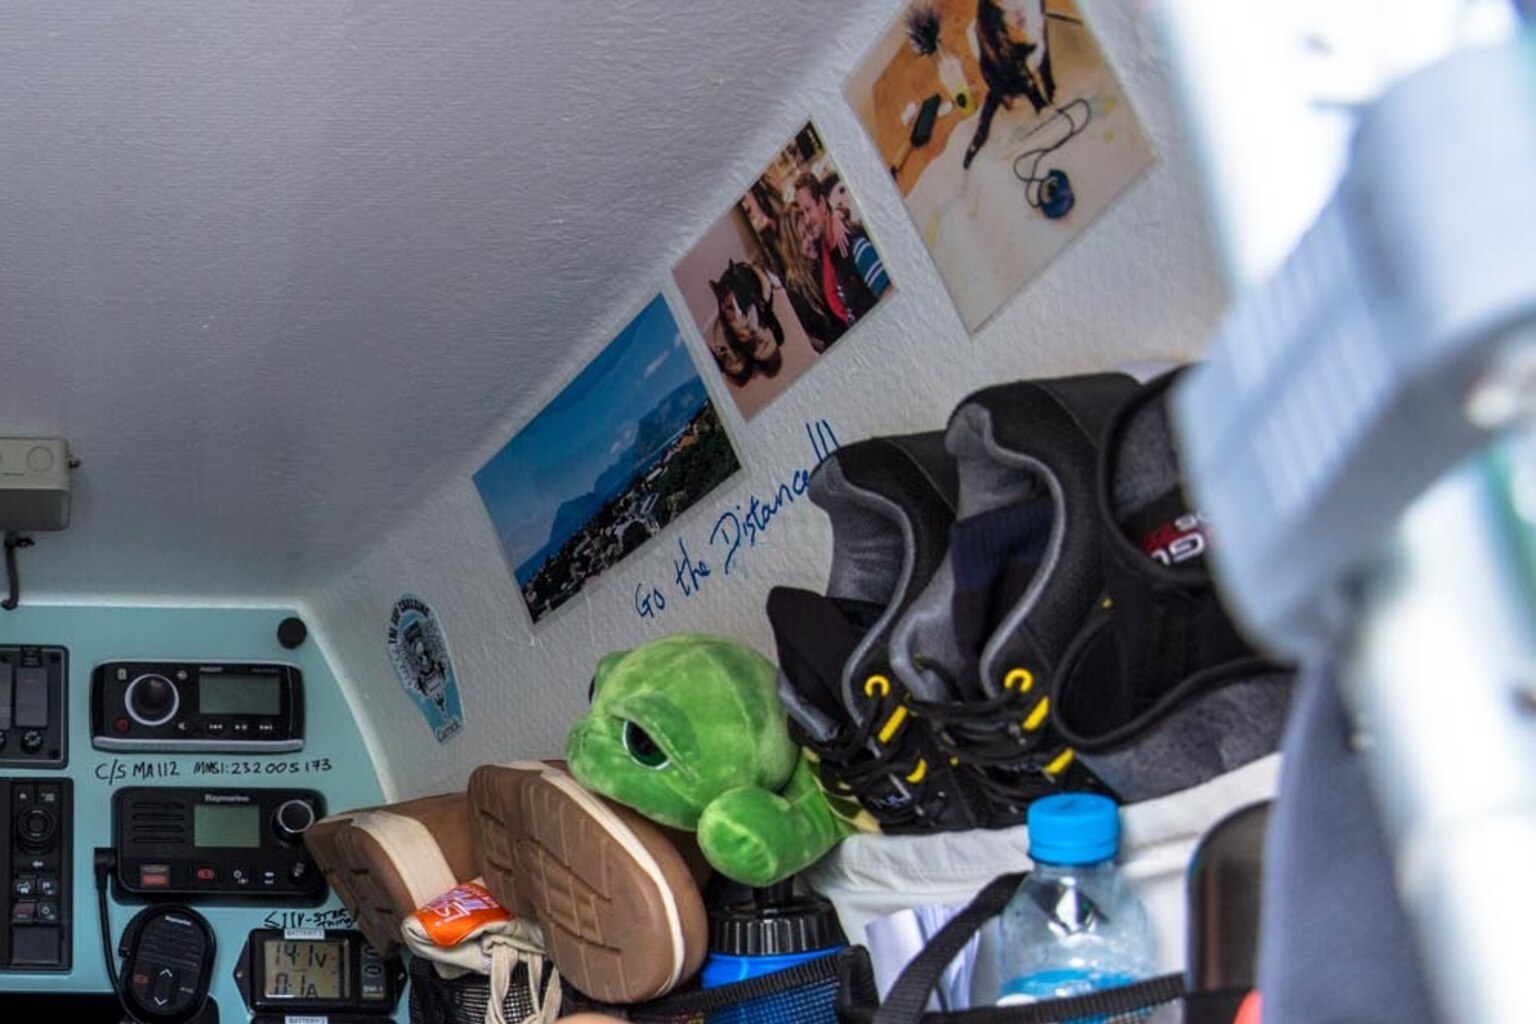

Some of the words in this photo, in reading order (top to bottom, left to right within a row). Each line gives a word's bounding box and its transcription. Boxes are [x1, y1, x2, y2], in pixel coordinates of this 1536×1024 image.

[635, 583, 665, 619] Go
[674, 538, 711, 597] the
[94, 759, 126, 785] C/S
